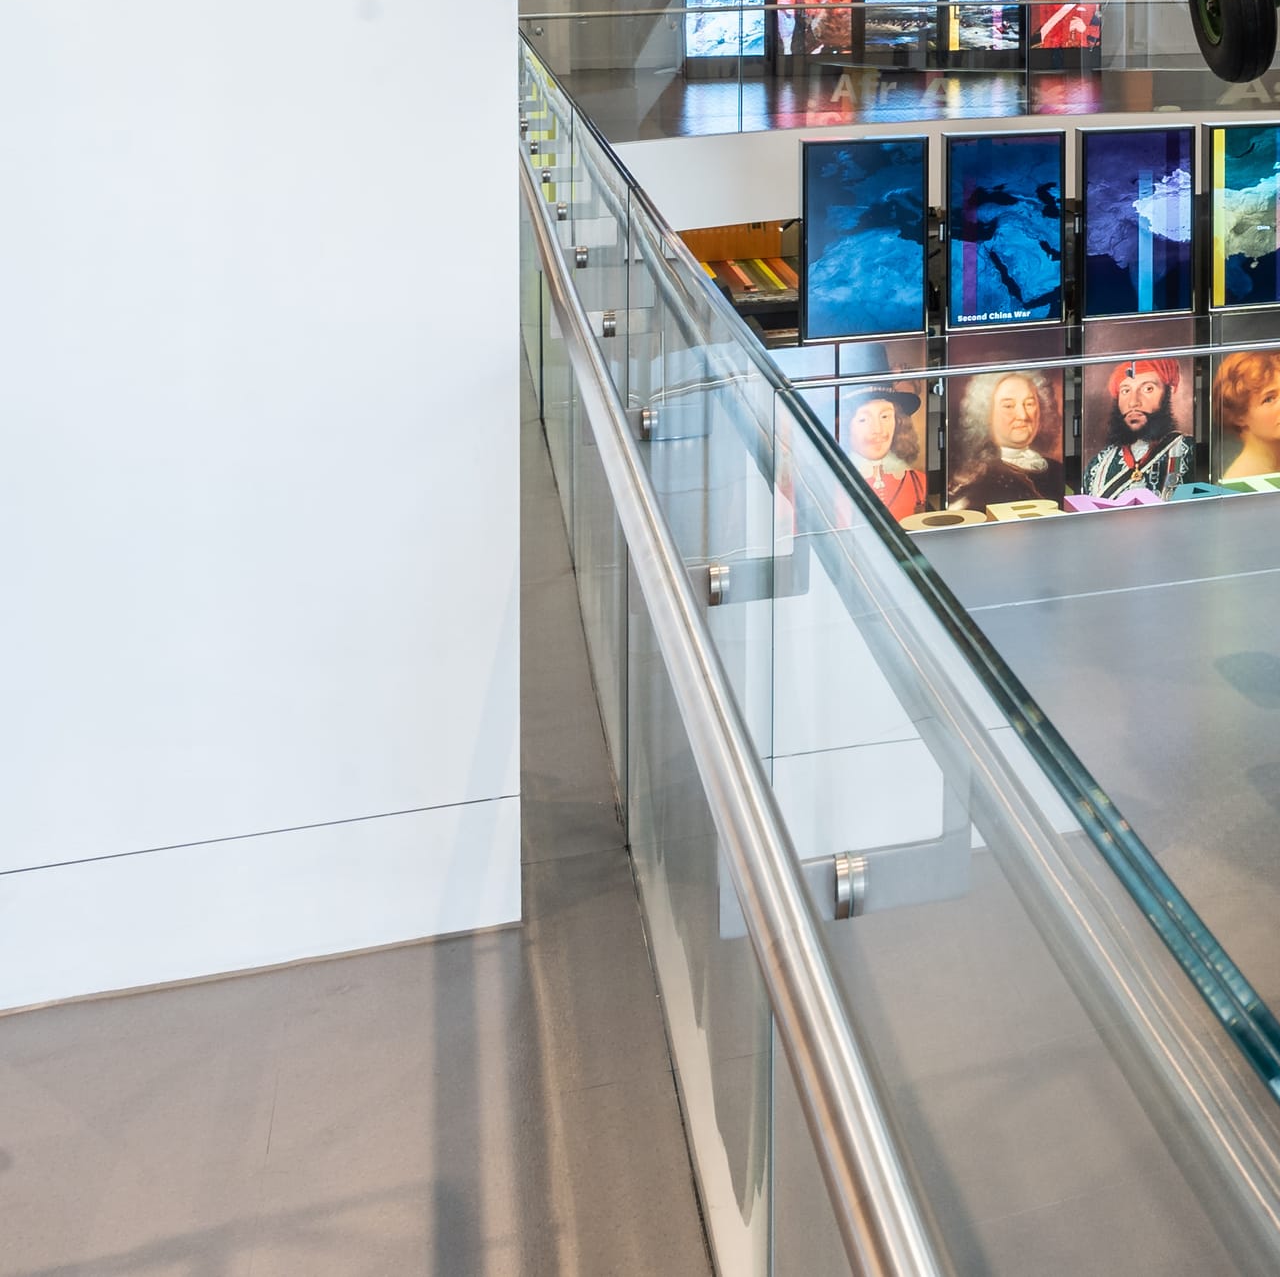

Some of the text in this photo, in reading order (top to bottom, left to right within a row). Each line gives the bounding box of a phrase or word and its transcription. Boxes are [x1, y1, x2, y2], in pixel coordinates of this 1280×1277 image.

[957, 310, 1031, 322] Second China War
